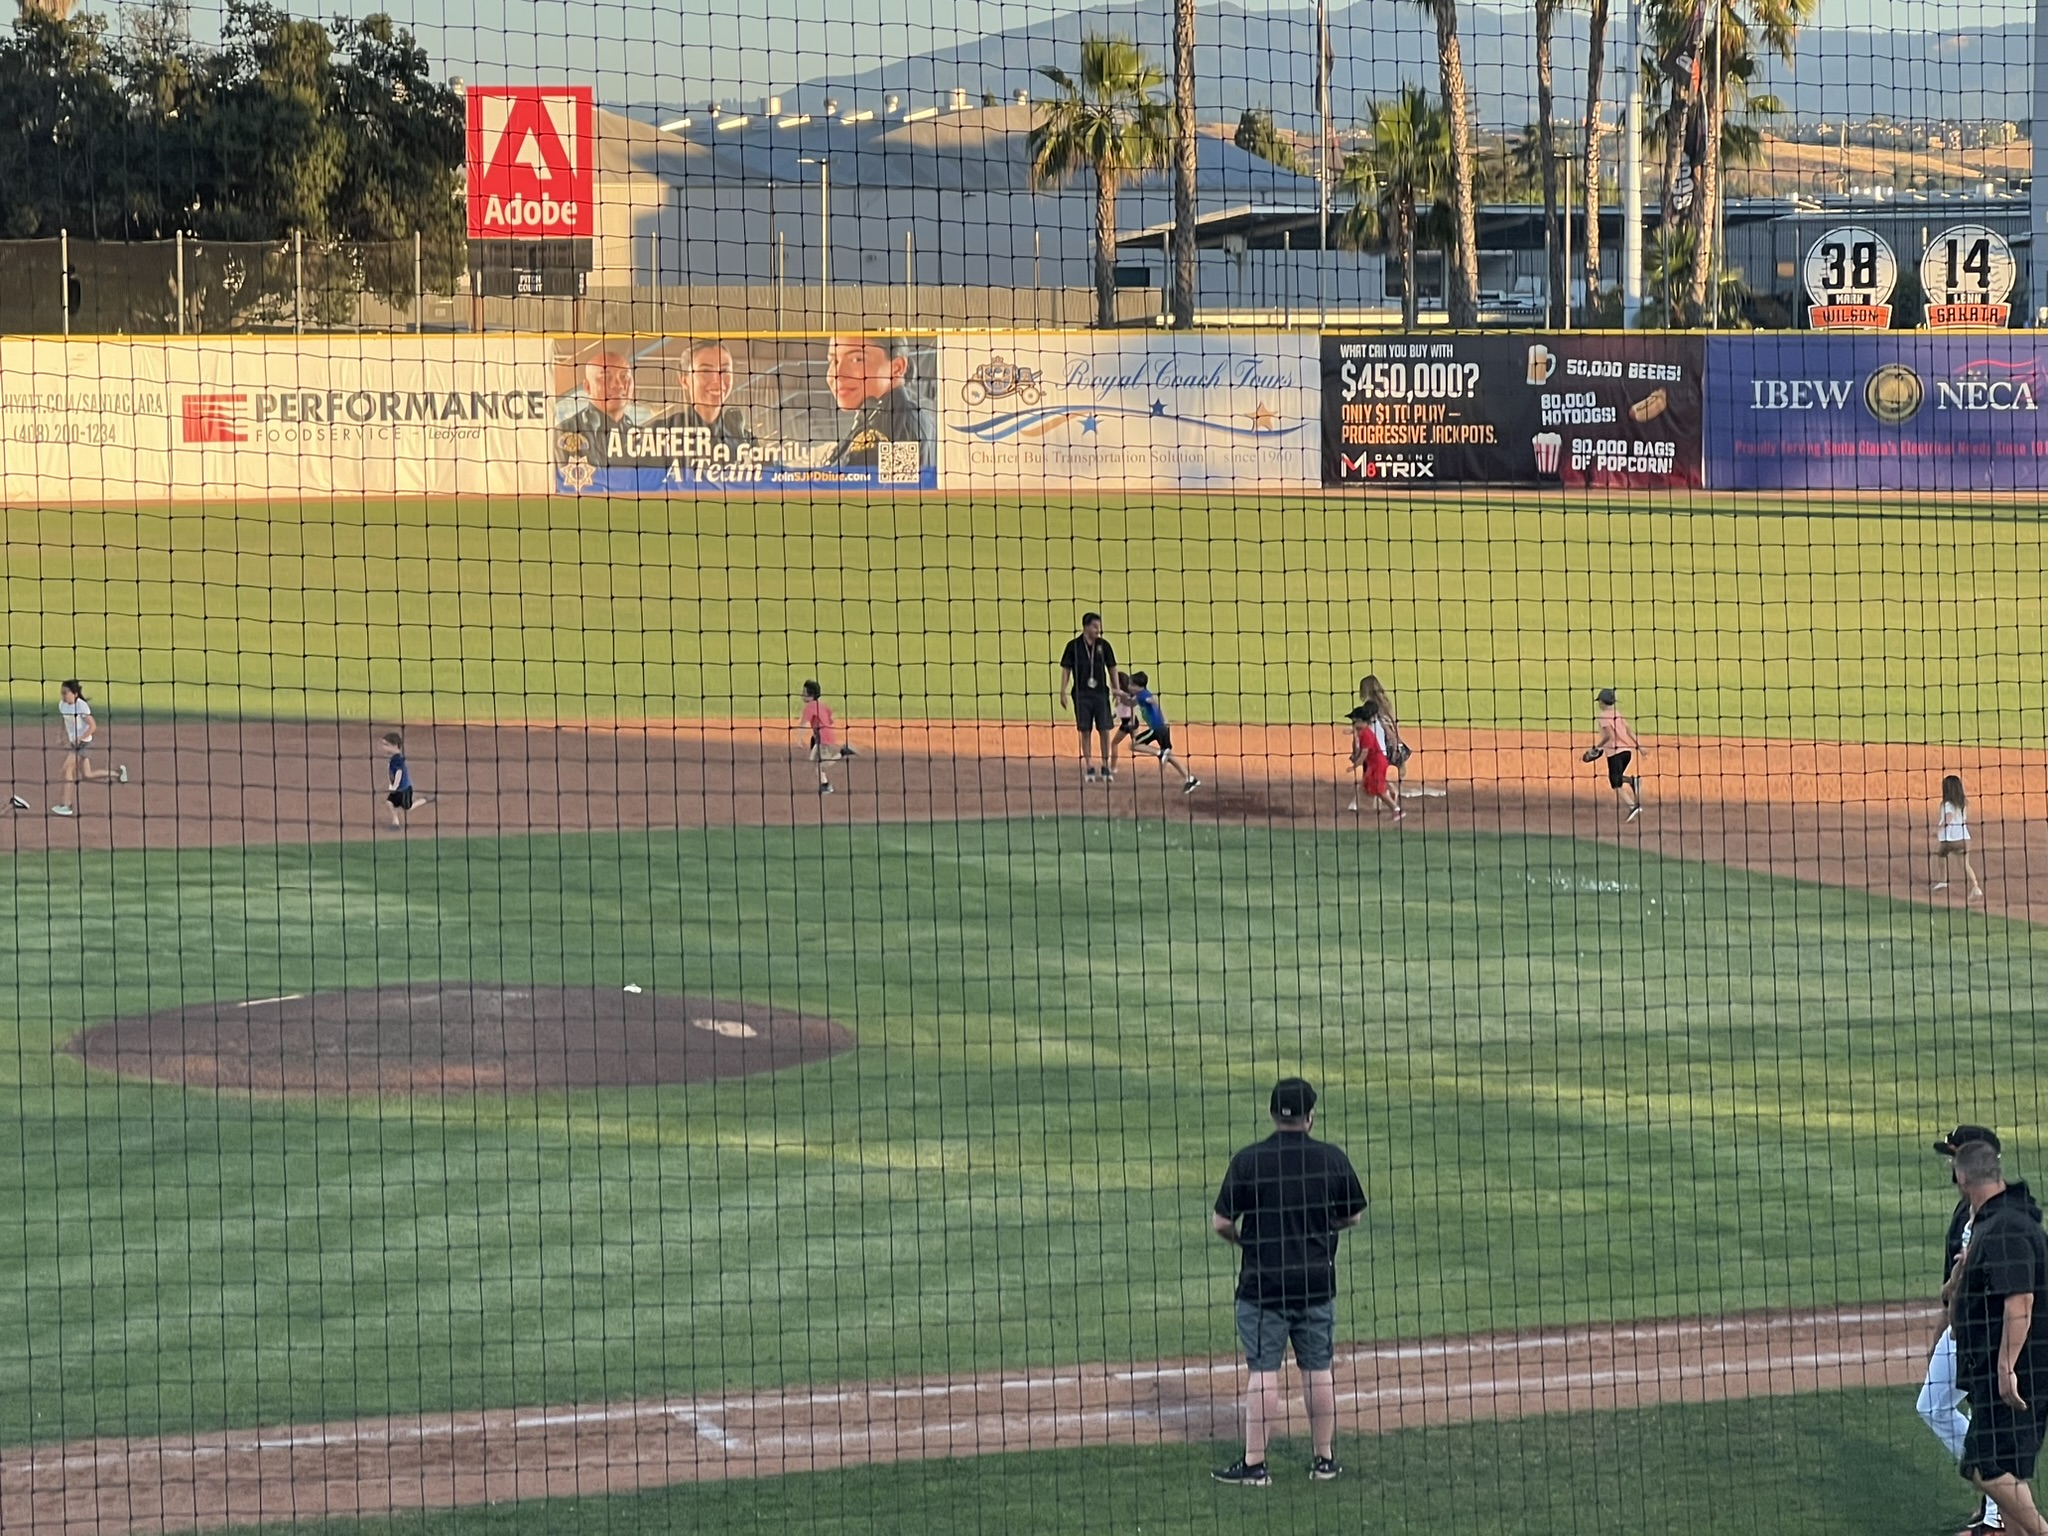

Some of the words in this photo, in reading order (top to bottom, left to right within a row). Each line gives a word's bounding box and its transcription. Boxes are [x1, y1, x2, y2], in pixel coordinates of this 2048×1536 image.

[484, 192, 578, 226] Adobe
[1821, 242, 1877, 289] 38
[1946, 239, 1991, 288] 14
[519, 275, 542, 284] PITCH
[1836, 293, 1864, 305] MARK
[1953, 293, 1982, 305] LENN
[1822, 309, 1877, 323] WILSON
[1937, 307, 1999, 323] SAKATA
[1340, 344, 1366, 358] WHAT
[1368, 344, 1387, 358] CAN
[1389, 344, 1407, 358] YOU
[1409, 344, 1428, 358] BUY
[1430, 344, 1453, 358] WITH
[1055, 358, 1150, 402] Royal
[1150, 358, 1228, 391] Coach
[1234, 358, 1295, 391] Tours
[1566, 359, 1623, 378] 50,000
[1628, 362, 1682, 382] BEERS!
[1341, 360, 1480, 404] $450,000?
[1541, 391, 1597, 410] 80,000
[1751, 379, 1854, 410] IBEW
[1937, 381, 2039, 410] NECA
[255, 391, 545, 423] PERFORMANCE
[1342, 404, 1373, 424] ONLY
[1375, 402, 1390, 425] $1
[1393, 404, 1411, 424] TO
[1414, 404, 1446, 424] PLAY
[1541, 406, 1617, 426] HOTDOGS!
[13, 424, 50, 443] (408)
[54, 424, 116, 443] 200-1234
[255, 427, 402, 442] FOODSERVICE
[428, 425, 482, 444] Ledyard
[607, 427, 623, 458] A
[626, 426, 712, 458] CAREER
[1341, 424, 1427, 444] PROGRESSIVE
[1430, 424, 1498, 444] JACKPOTS.
[713, 443, 731, 462] A
[1571, 438, 1628, 457] 90,000
[1633, 441, 1676, 457] BAGS
[971, 451, 1019, 464] Charter
[1024, 451, 1049, 464] Bus
[1052, 451, 1146, 467] Transportation
[1223, 451, 1257, 464] since
[1341, 451, 1434, 478] M8TRIX
[1571, 455, 1592, 471] OF
[1597, 456, 1673, 474] POPCORN!
[662, 458, 683, 483] A
[691, 458, 763, 483] Team
